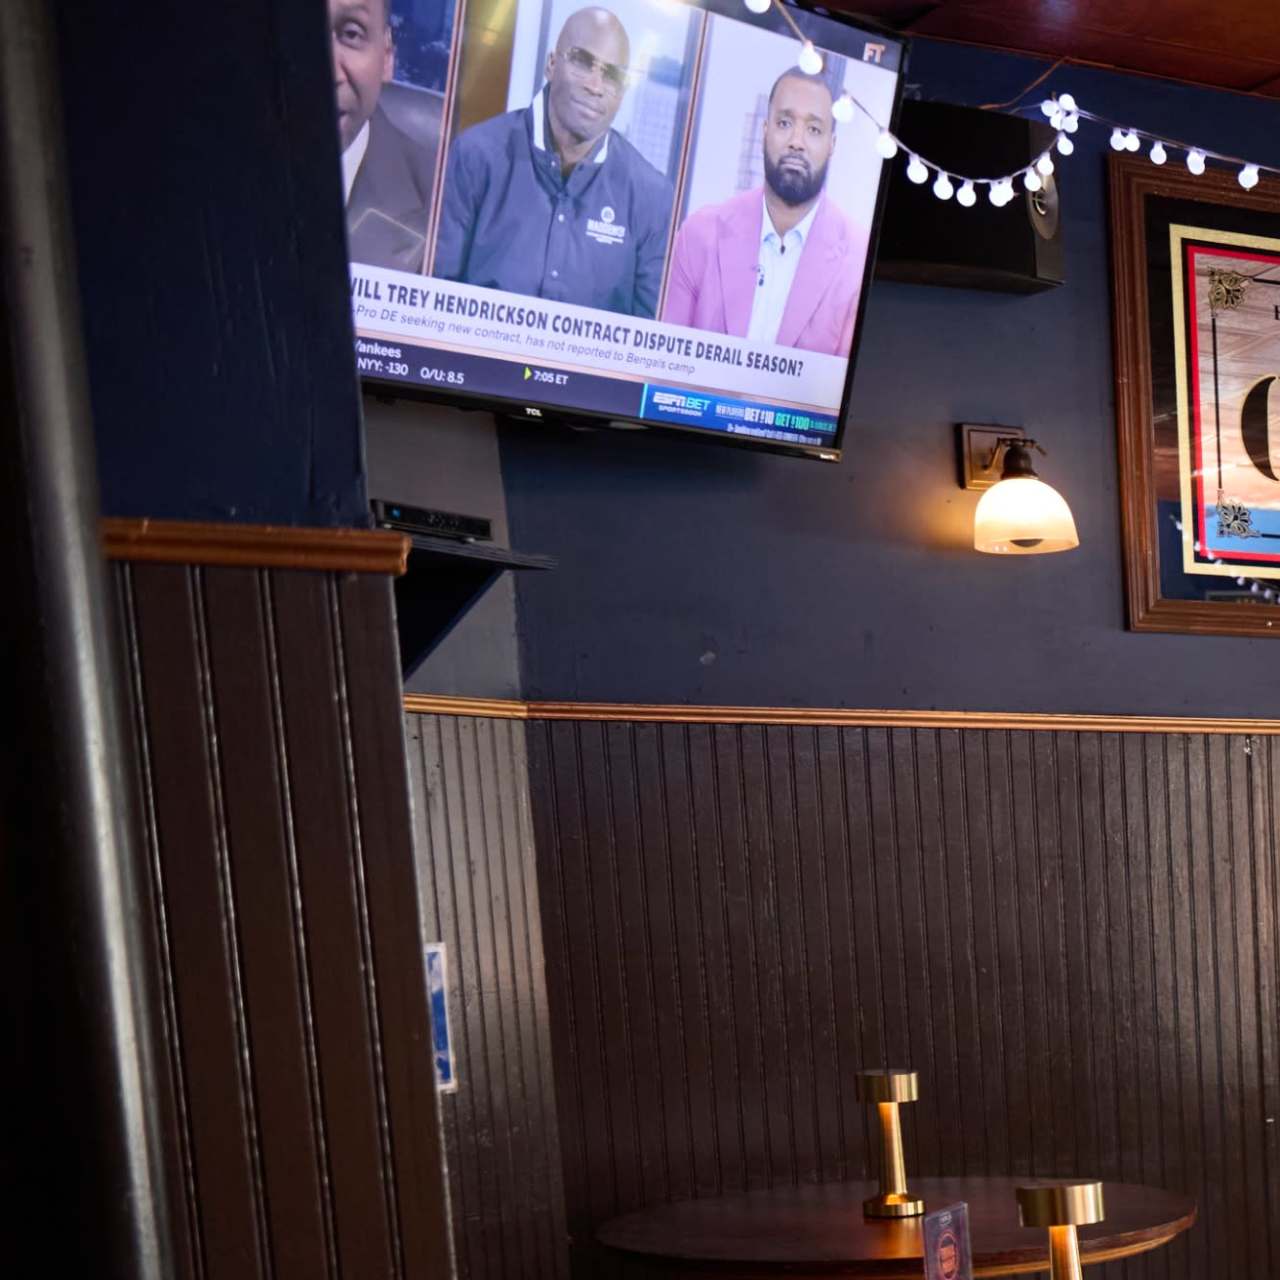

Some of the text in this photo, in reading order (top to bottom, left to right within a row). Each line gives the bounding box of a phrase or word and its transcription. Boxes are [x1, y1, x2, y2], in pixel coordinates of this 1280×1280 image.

[863, 42, 885, 63] FT
[381, 309, 398, 321] DE
[401, 315, 445, 333] seeking
[448, 323, 471, 335] new
[474, 326, 521, 345] contract,
[526, 335, 546, 348] has
[547, 339, 565, 352] not
[567, 342, 611, 360] reported
[613, 349, 624, 361] to
[626, 351, 666, 370] Bengals
[668, 361, 696, 375] camp
[387, 284, 430, 309] TREY
[434, 292, 548, 330] HENDRICKSON
[552, 314, 631, 346] CONTRACT
[633, 331, 692, 358] DISPUTE
[695, 343, 742, 367] DERAIL
[746, 352, 804, 377] SEASON?
[357, 358, 383, 372] NYY:
[446, 371, 465, 384] 8.5
[555, 374, 569, 385] ET
